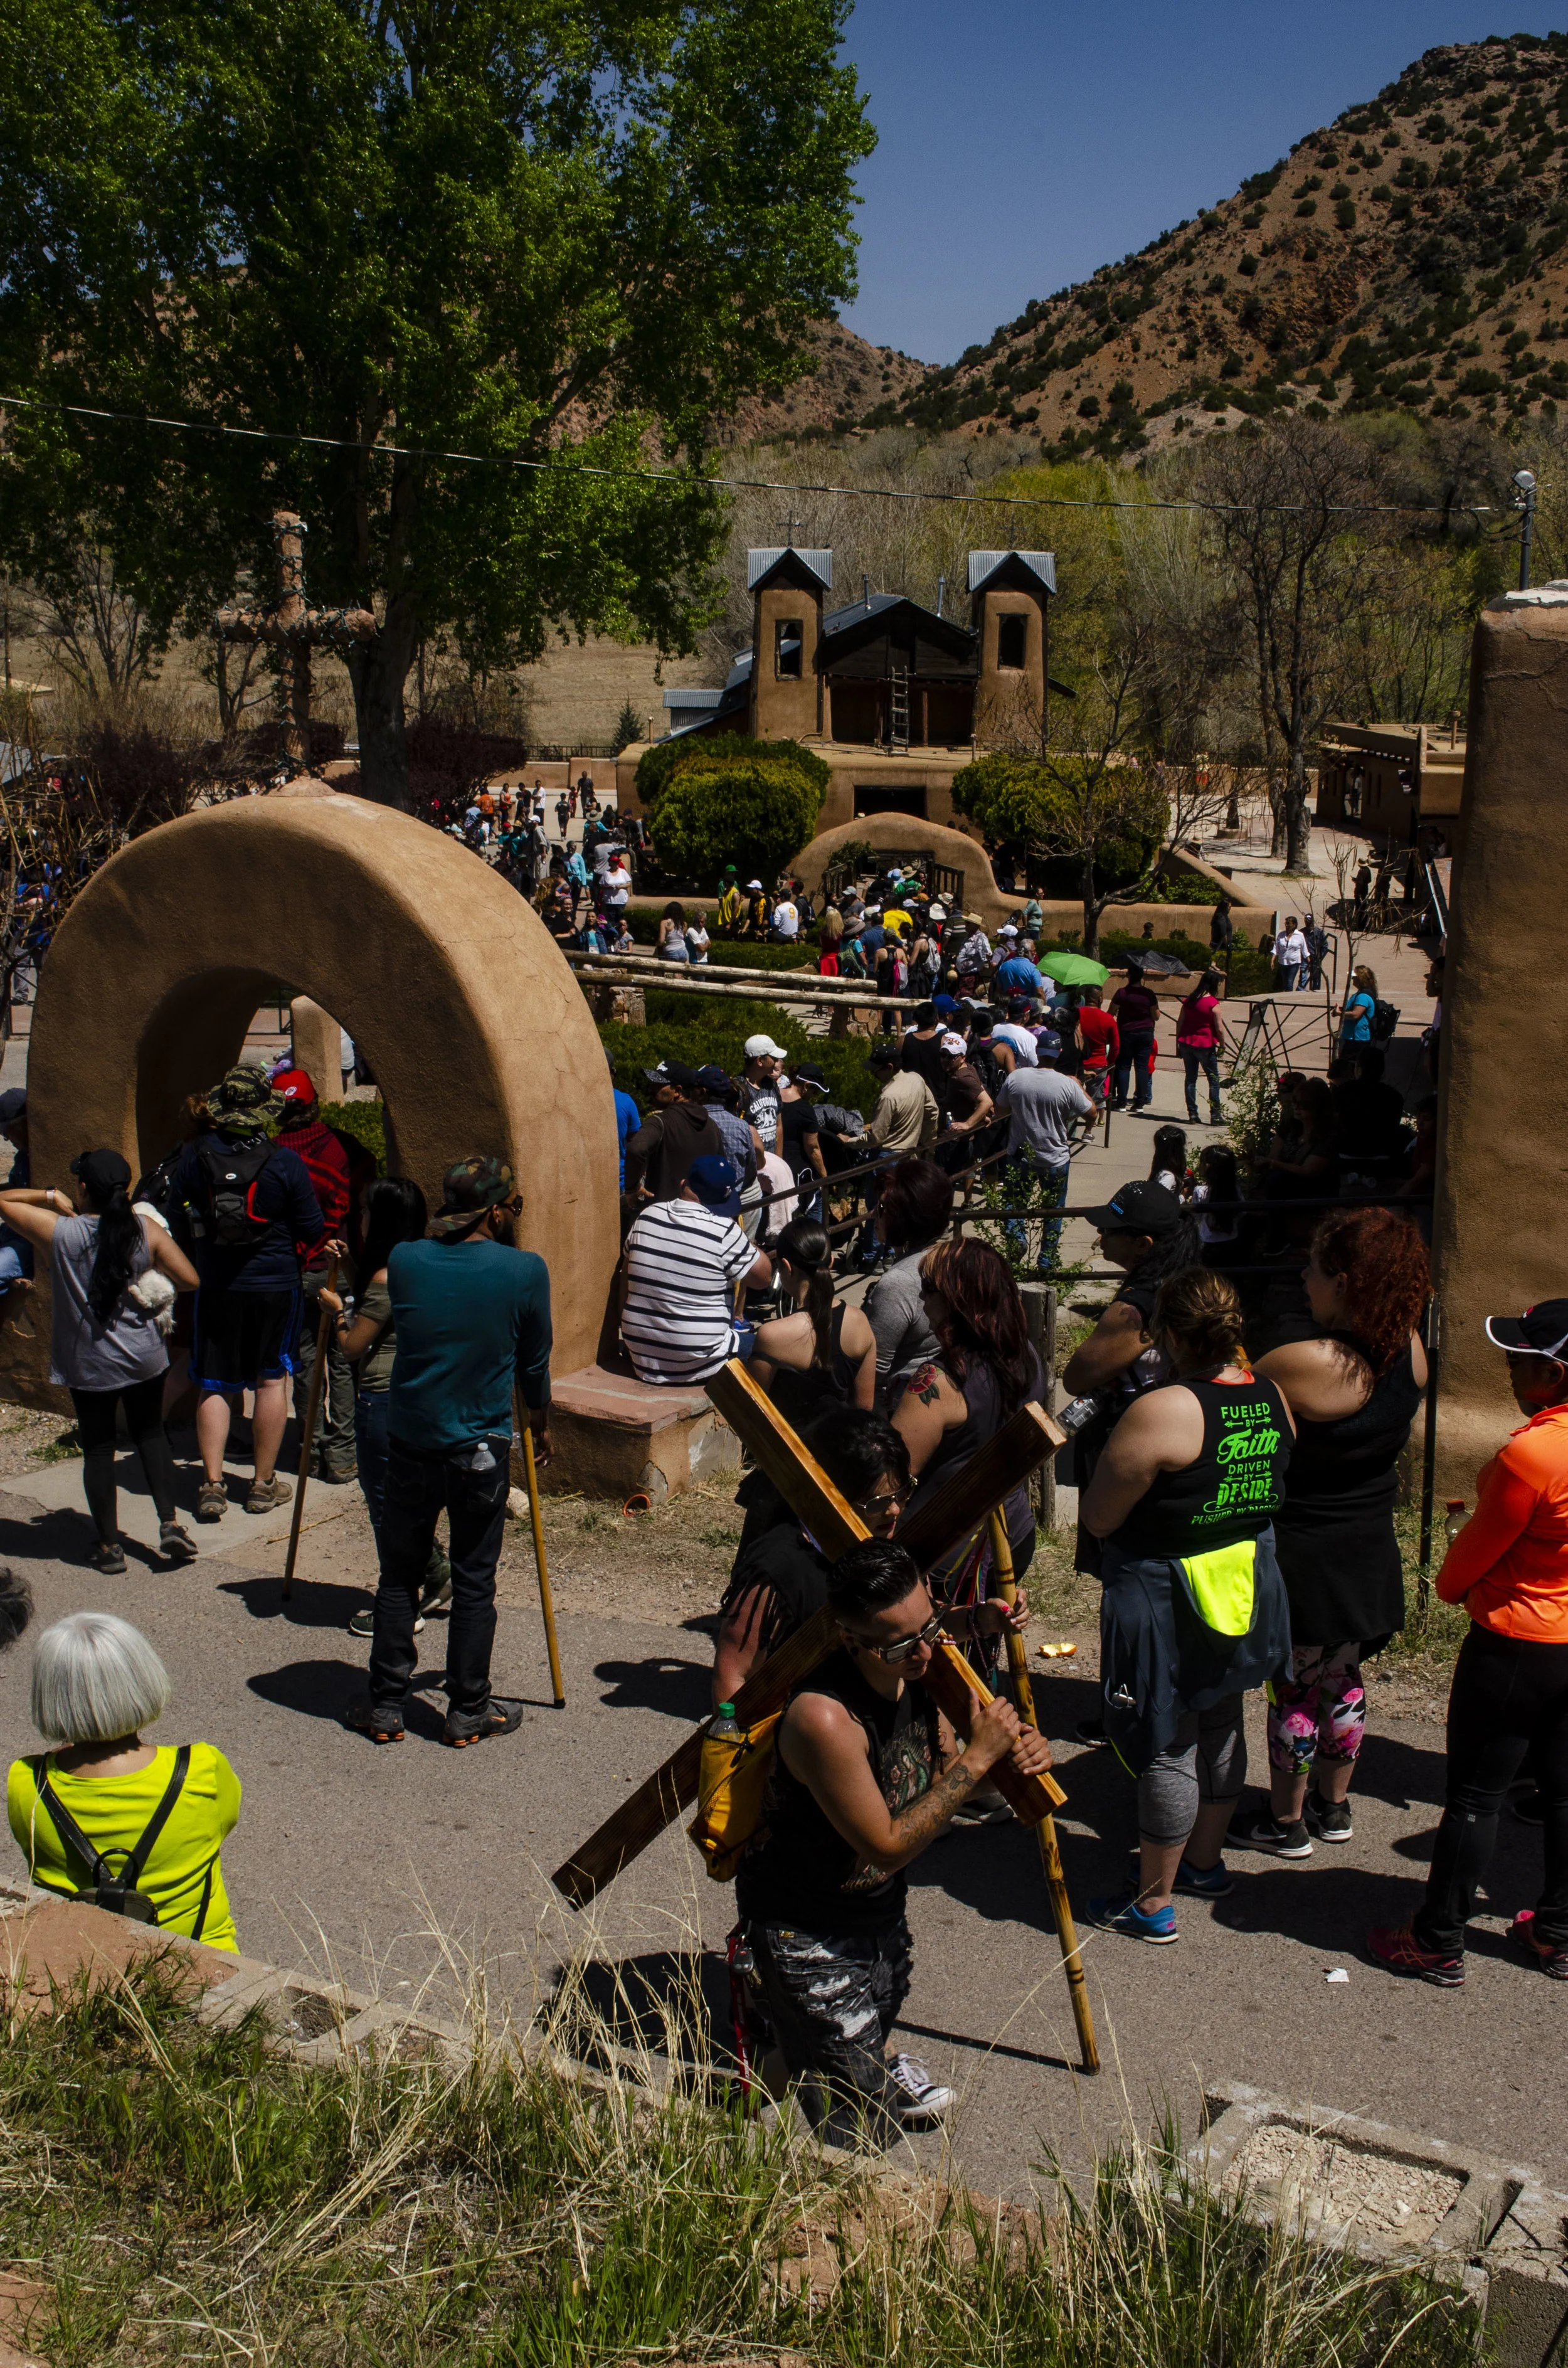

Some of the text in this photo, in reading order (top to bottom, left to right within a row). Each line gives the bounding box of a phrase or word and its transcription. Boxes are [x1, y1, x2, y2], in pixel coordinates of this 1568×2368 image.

[788, 907, 796, 919] 9
[749, 1096, 778, 1114] CALIFORNIA
[1220, 1403, 1270, 1419] FUELED
[1246, 1418, 1255, 1427] BY
[1216, 1428, 1281, 1464] Faith
[1228, 1460, 1271, 1475] DRIVEN
[1244, 1473, 1254, 1482] BY
[1216, 1478, 1273, 1506] DESIRE
[1190, 1510, 1232, 1525] PUSHED
[1236, 1507, 1247, 1516] BY
